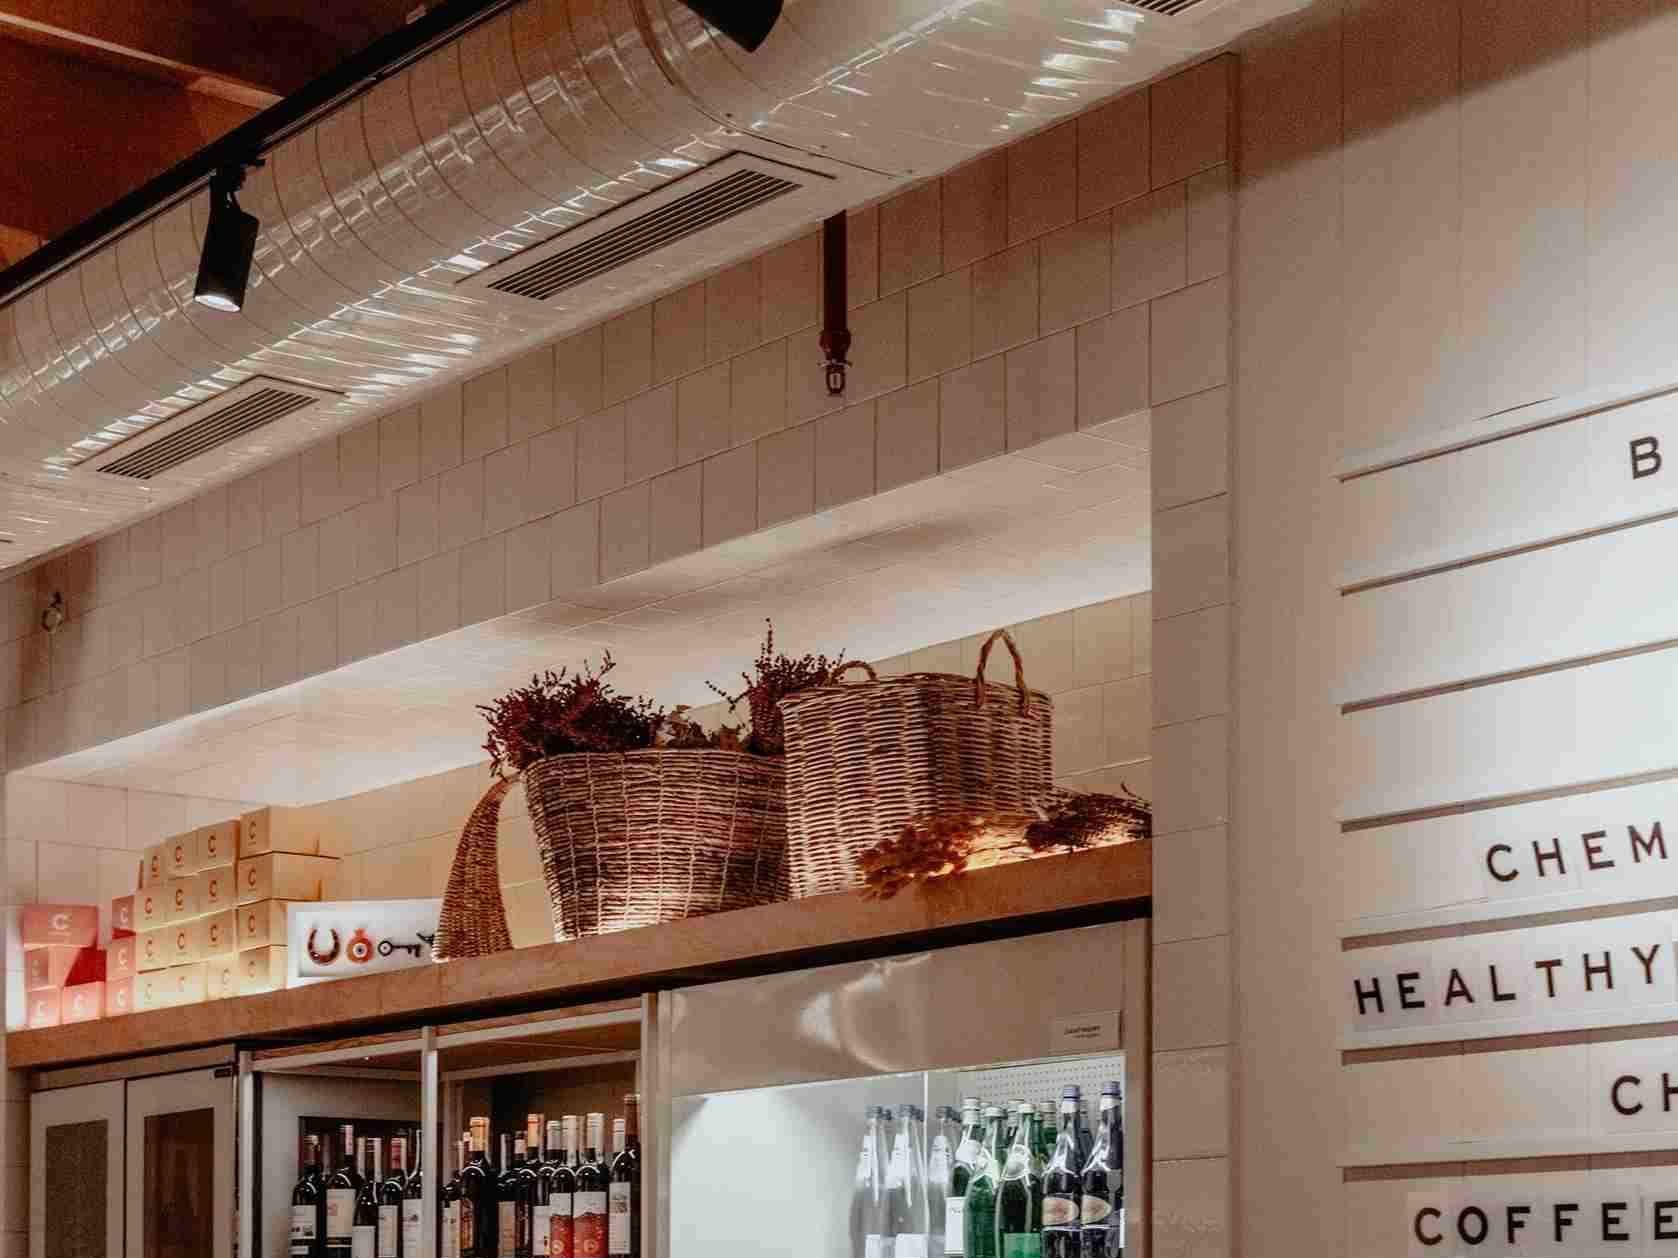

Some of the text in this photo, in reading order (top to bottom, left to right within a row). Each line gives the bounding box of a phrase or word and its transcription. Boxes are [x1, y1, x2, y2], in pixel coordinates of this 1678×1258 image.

[1630, 437, 1662, 479] B
[1486, 822, 1668, 882] CHEM
[1352, 943, 1661, 1017] HEALTHY
[1413, 1199, 1678, 1247] COFFEE
